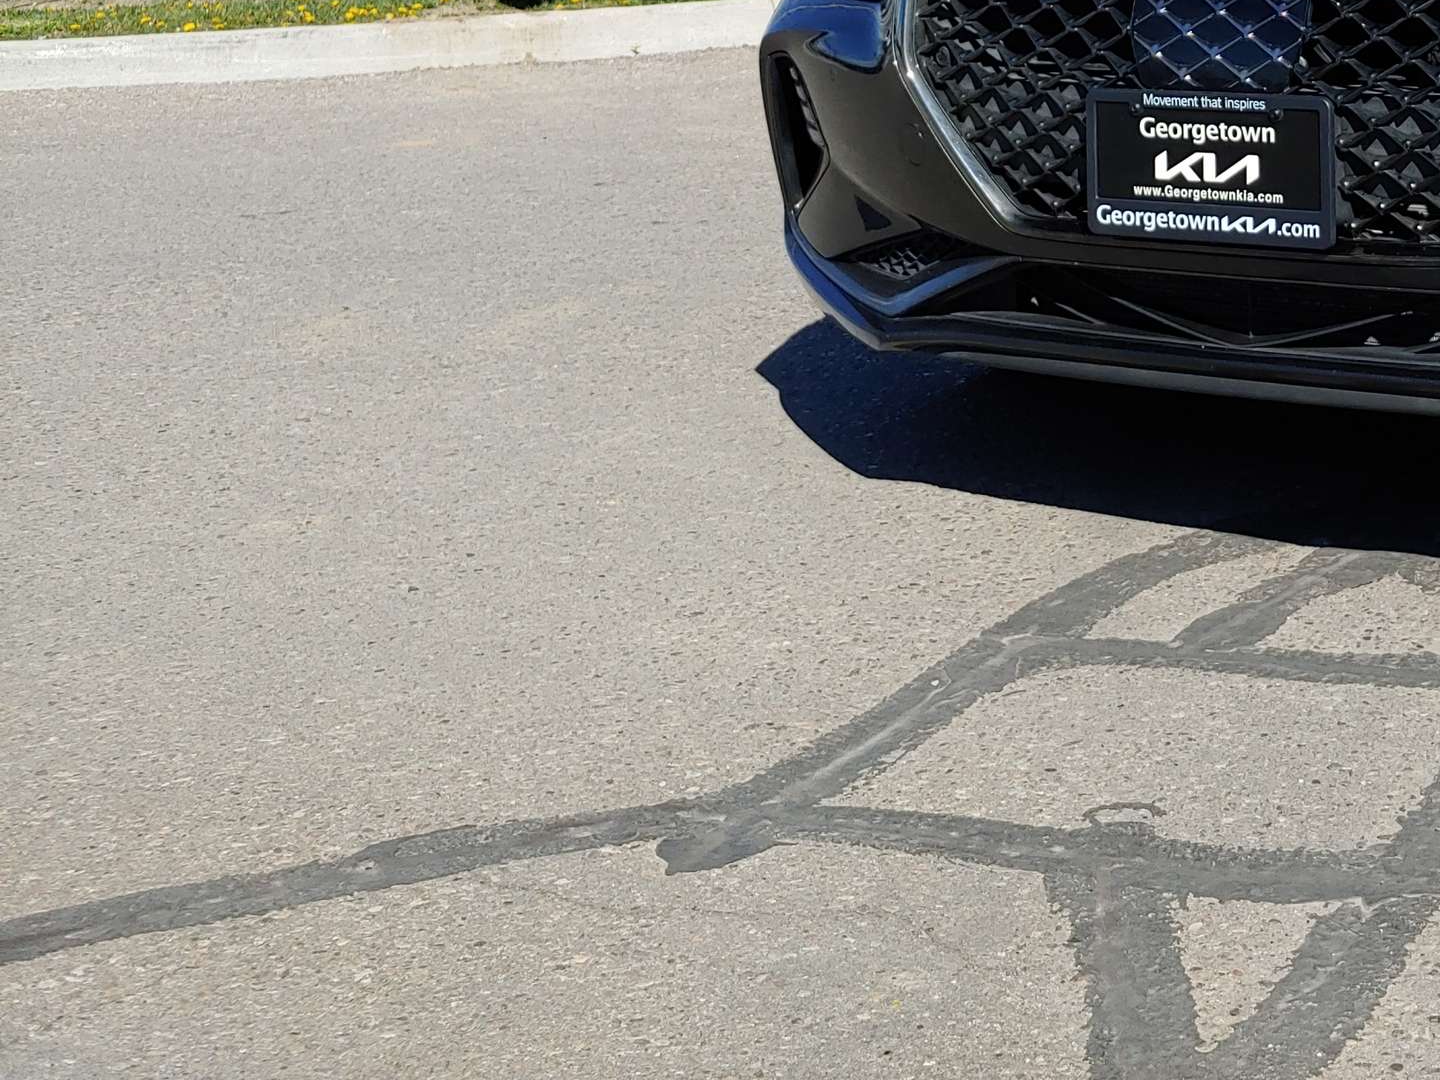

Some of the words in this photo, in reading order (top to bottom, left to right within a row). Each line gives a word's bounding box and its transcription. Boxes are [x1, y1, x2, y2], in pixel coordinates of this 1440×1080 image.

[1143, 93, 1199, 108] Movement
[1200, 96, 1222, 109] that
[1224, 96, 1266, 111] inspires
[1139, 116, 1276, 145] Georgetown
[1154, 150, 1260, 185] KIA
[1133, 184, 1284, 205] www.Georgetownkia.com
